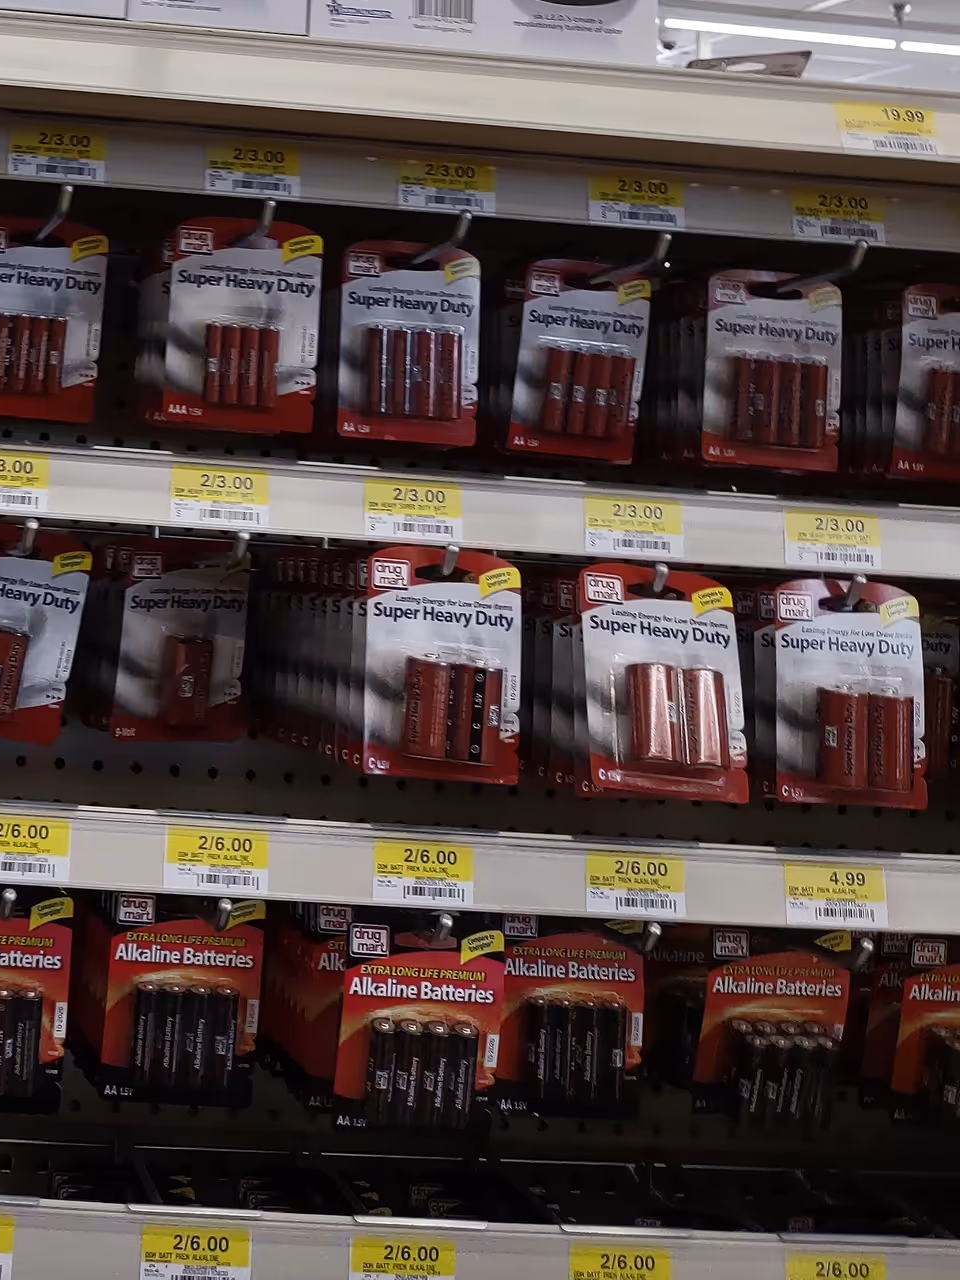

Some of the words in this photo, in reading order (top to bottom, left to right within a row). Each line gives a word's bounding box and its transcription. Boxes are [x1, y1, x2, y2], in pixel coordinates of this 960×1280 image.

[882, 108, 925, 123] 19.99
[39, 132, 90, 147] 2/3.00
[233, 148, 285, 163] 2/3.00
[425, 162, 476, 179] 2/3.00
[618, 179, 668, 195] 2/3.00
[818, 195, 869, 210] 2/3.00
[17, 270, 63, 289] Heavy
[65, 276, 101, 295] Duty
[177, 269, 223, 289] Super
[226, 273, 275, 293] Heavy
[277, 278, 315, 299] Duty
[347, 291, 390, 310] Super
[392, 296, 438, 314] Heavy
[441, 299, 475, 319] Duty
[528, 310, 568, 329] Super
[570, 314, 611, 333] Heavy
[613, 318, 644, 339] Duty
[715, 318, 757, 339] Super
[760, 323, 803, 342] Heavy
[805, 327, 838, 346] Duty
[168, 404, 187, 416] AAA
[200, 475, 253, 490] 2/3.00
[393, 488, 446, 503] 2/3.00
[613, 504, 663, 520] 2/3.00
[814, 517, 865, 533] 2/3.00
[375, 562, 403, 576] drug
[379, 574, 407, 587] mart
[589, 577, 615, 590] drug
[43, 592, 79, 614] Duty
[592, 590, 622, 601] mart
[373, 602, 420, 622] Super
[422, 607, 473, 630] Heavy
[476, 611, 514, 632] Duty
[590, 615, 637, 635] Super
[640, 622, 689, 644] Heavy
[693, 629, 731, 649] Duty
[780, 634, 826, 653] Super
[829, 638, 875, 657] Heavy
[878, 640, 915, 658] Duty
[598, 768, 606, 780] C
[198, 836, 252, 852] 2/6.00
[403, 849, 457, 864] 2/6.00
[614, 860, 668, 877] 2/6.00
[829, 871, 865, 886] 4.99
[354, 928, 381, 941] drug
[357, 942, 387, 952] mart
[115, 943, 181, 964] Alkaline
[183, 948, 253, 968] Batteries
[361, 965, 390, 975] EXTRA
[392, 967, 418, 977] LONG
[420, 968, 439, 978] LIFE
[440, 970, 485, 982] PREMIUM
[504, 960, 566, 978] Alkaline
[568, 962, 635, 982] Batteries
[349, 976, 418, 998] Alkaline
[420, 982, 494, 1004] Batteries
[713, 977, 774, 995] Alkaline
[776, 979, 842, 996] Batteries
[909, 984, 960, 1001] Alkalin
[337, 1115, 350, 1126] AA
[173, 1234, 229, 1252] 2/6.00
[384, 1244, 440, 1262] 2/6.00
[600, 1255, 655, 1271] 2/6.00
[815, 1262, 869, 1278] 2/6.00
